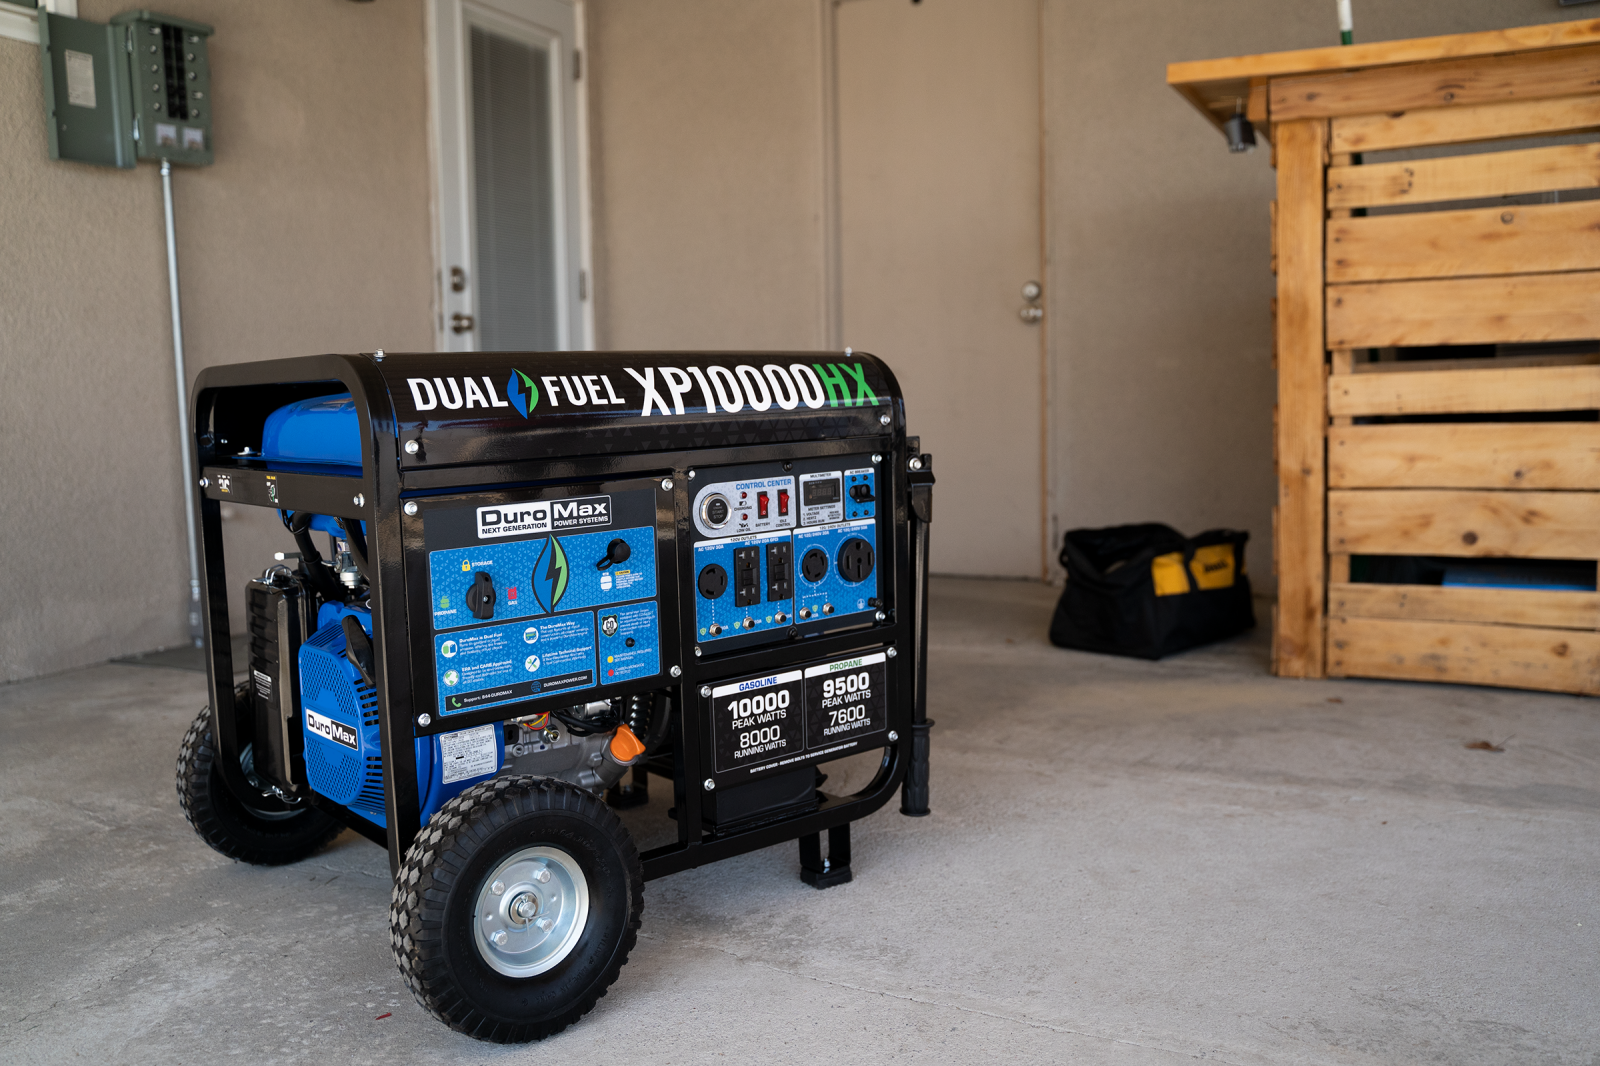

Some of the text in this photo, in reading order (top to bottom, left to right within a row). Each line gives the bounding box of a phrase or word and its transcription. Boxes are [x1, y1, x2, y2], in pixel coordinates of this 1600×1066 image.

[406, 363, 879, 417] DUAL FUEL XP10000HX
[736, 478, 792, 490] CONTROL CENTER
[482, 522, 548, 534] NEXT GENERATION
[554, 516, 608, 527] POWER SYSTEMS
[829, 658, 862, 672] PROPANE
[738, 676, 778, 692] GASOLINE
[823, 672, 870, 698] 9500
[727, 690, 790, 720] 10000
[822, 689, 872, 708] PEAK WATTS
[732, 709, 786, 730] PEAK WATTS
[828, 704, 866, 726] 7600
[740, 724, 780, 748] 8000
[824, 718, 870, 736] RUNNING WATTS
[734, 739, 786, 759] RUNNING WATTS
